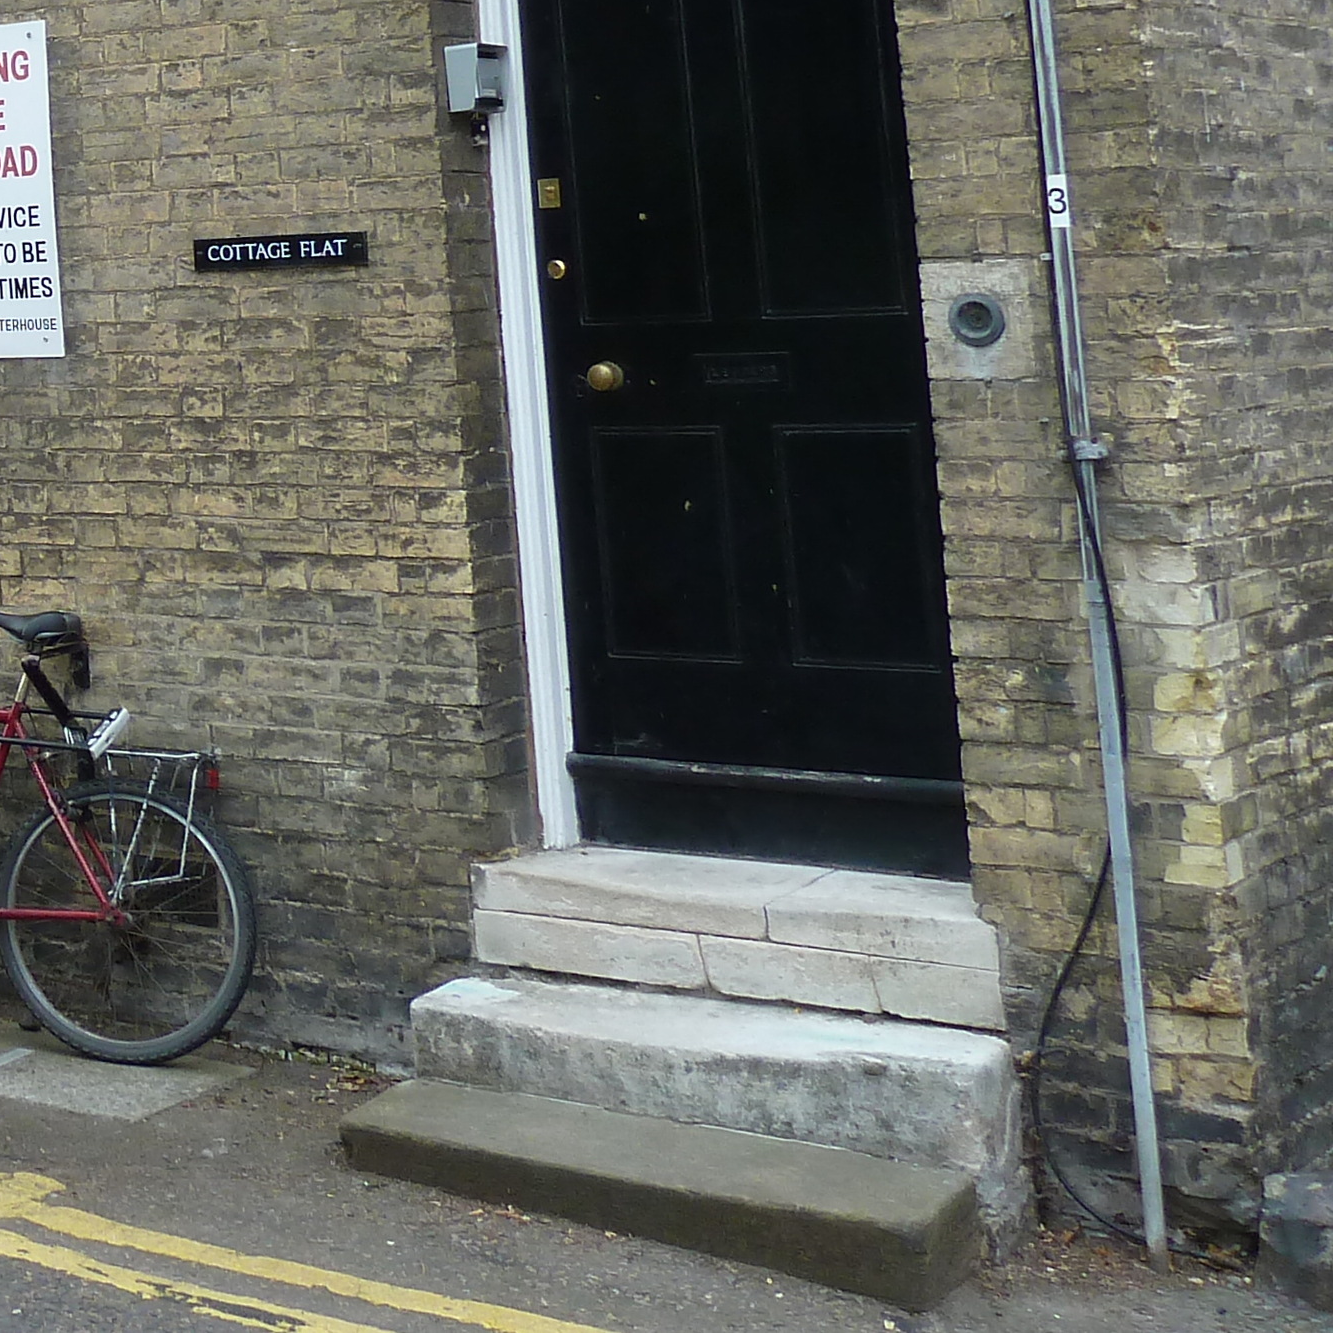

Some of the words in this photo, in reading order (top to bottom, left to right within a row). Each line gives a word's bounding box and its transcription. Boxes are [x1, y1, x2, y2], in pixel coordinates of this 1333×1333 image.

[1048, 187, 1067, 215] 3
[22, 241, 48, 264] BE
[207, 242, 291, 262] COTTAGE
[299, 239, 349, 258] FLAT
